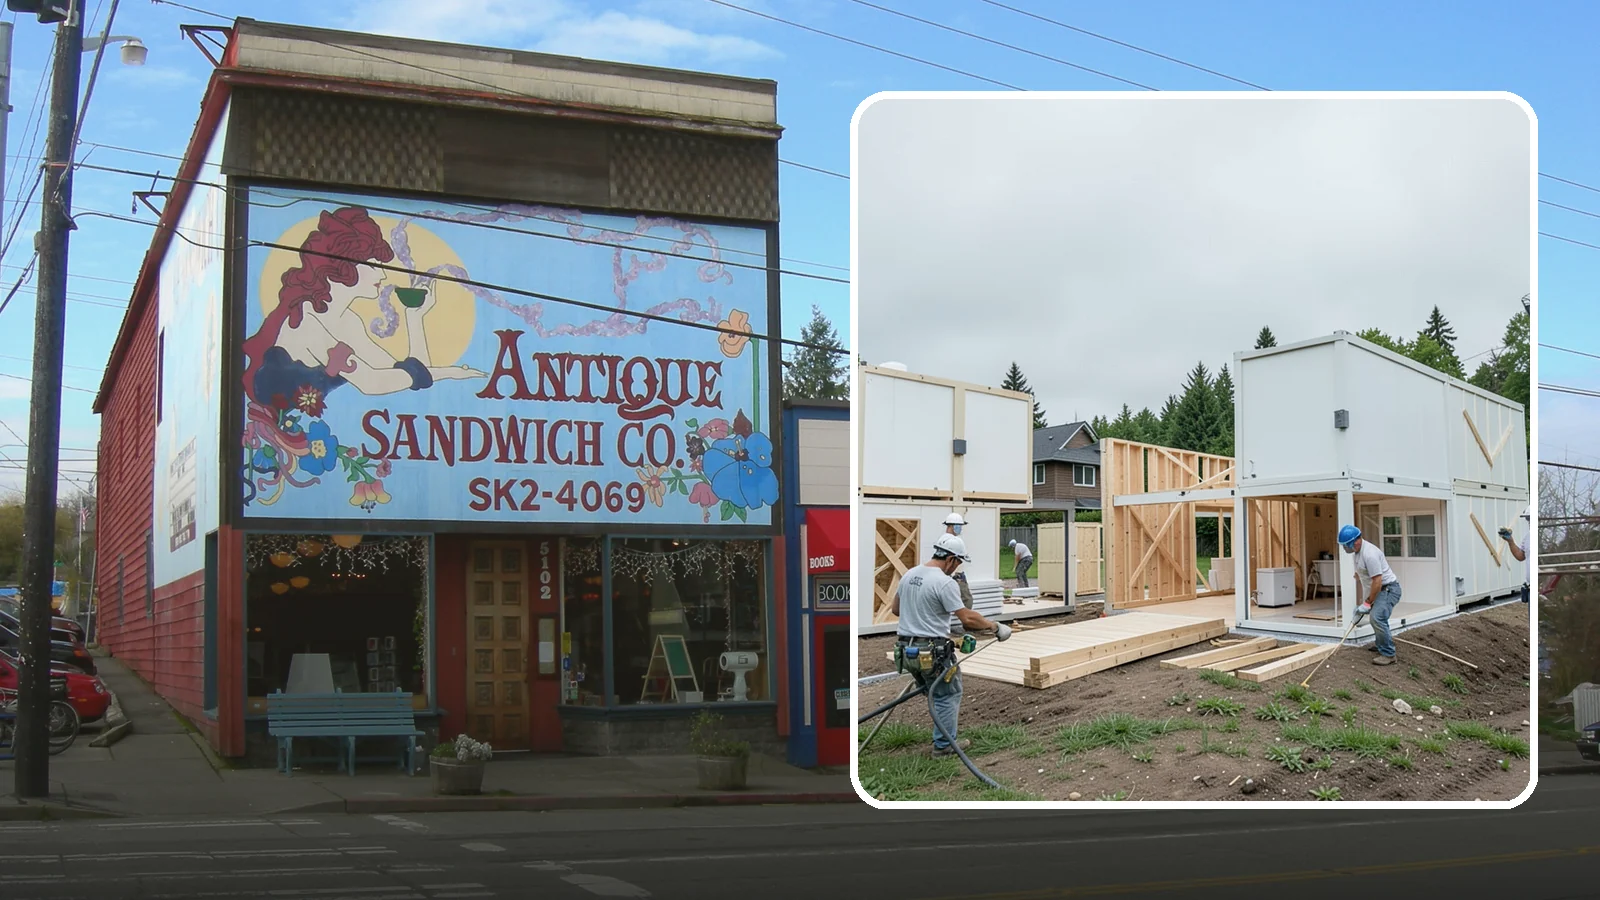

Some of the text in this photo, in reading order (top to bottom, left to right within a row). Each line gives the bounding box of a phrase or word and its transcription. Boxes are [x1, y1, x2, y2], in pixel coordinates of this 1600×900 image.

[476, 329, 723, 421] ANTIQUE
[361, 408, 684, 469] SANDWICH CO.
[468, 477, 646, 512] SK2-4069
[540, 541, 551, 599] 5102
[809, 555, 835, 569] BOOKS
